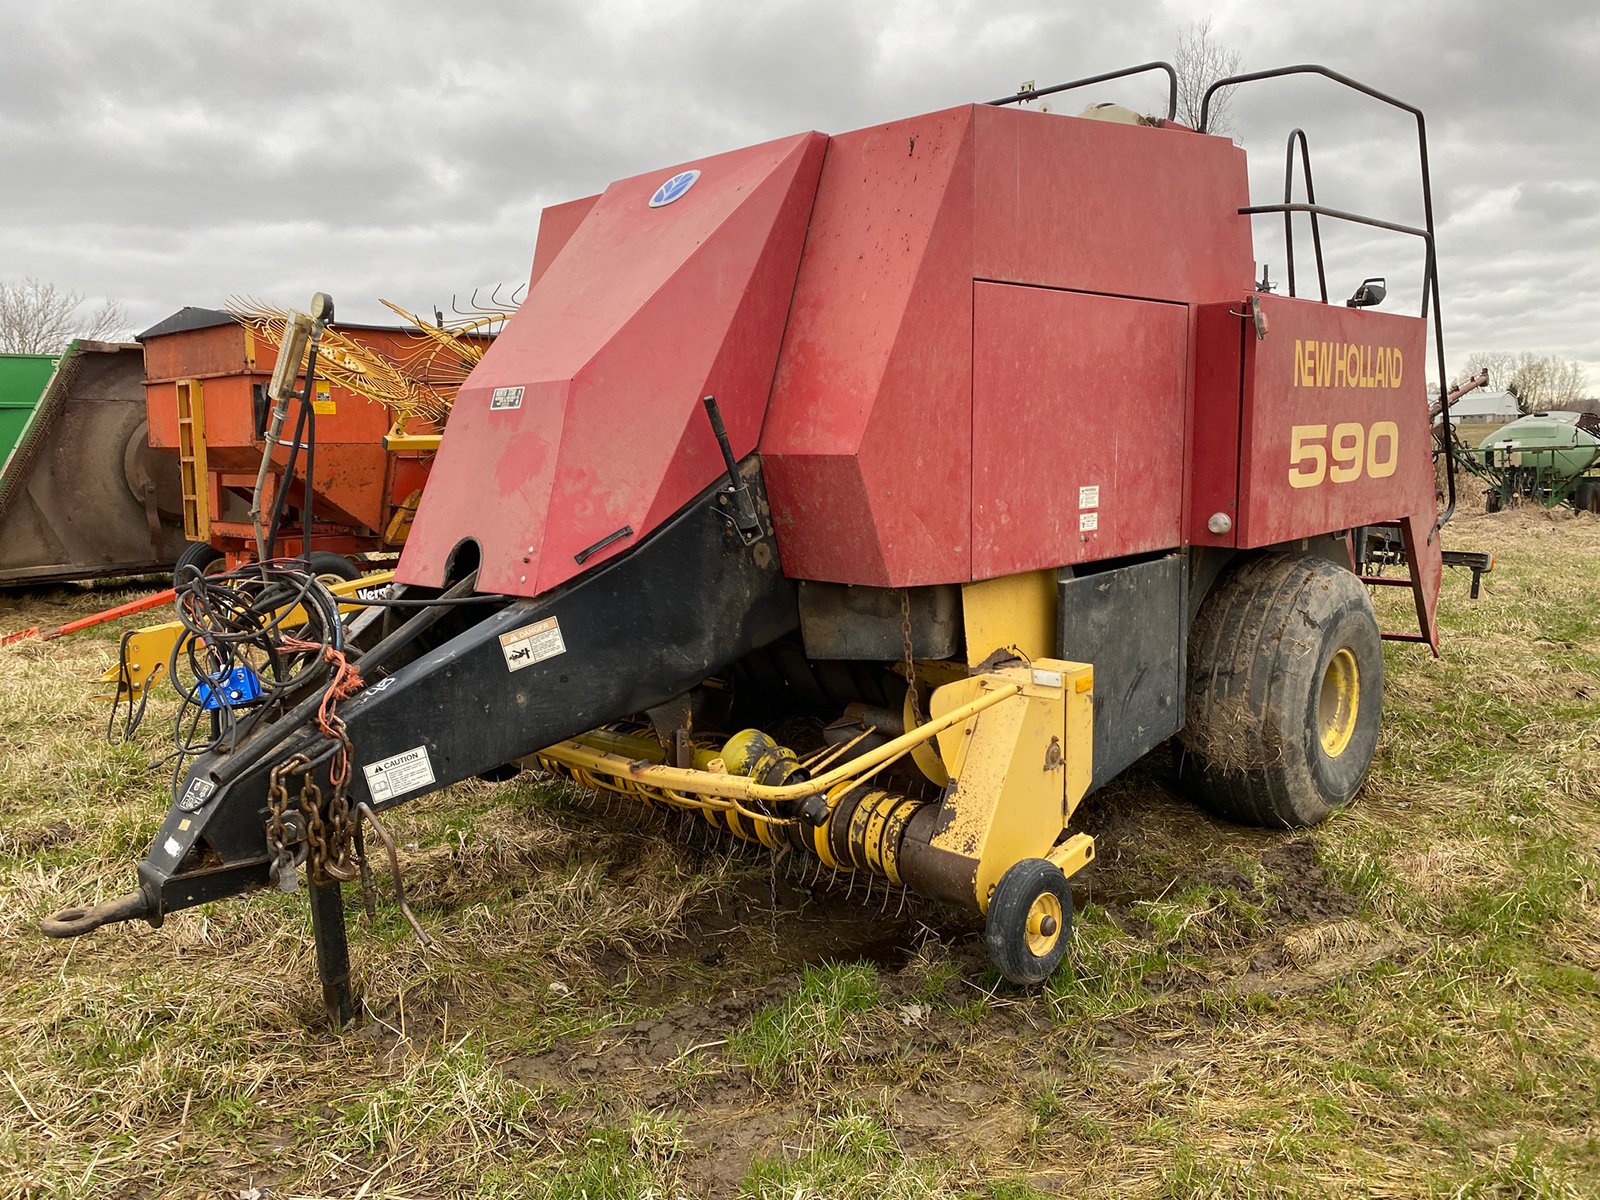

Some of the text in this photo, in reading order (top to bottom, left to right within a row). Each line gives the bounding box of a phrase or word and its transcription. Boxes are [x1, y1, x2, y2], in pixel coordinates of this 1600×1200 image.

[1294, 339, 1403, 388] NEW HOLLAND
[1288, 421, 1399, 489] 590
[518, 621, 549, 638] DANGER
[383, 751, 419, 770] CAUTION
